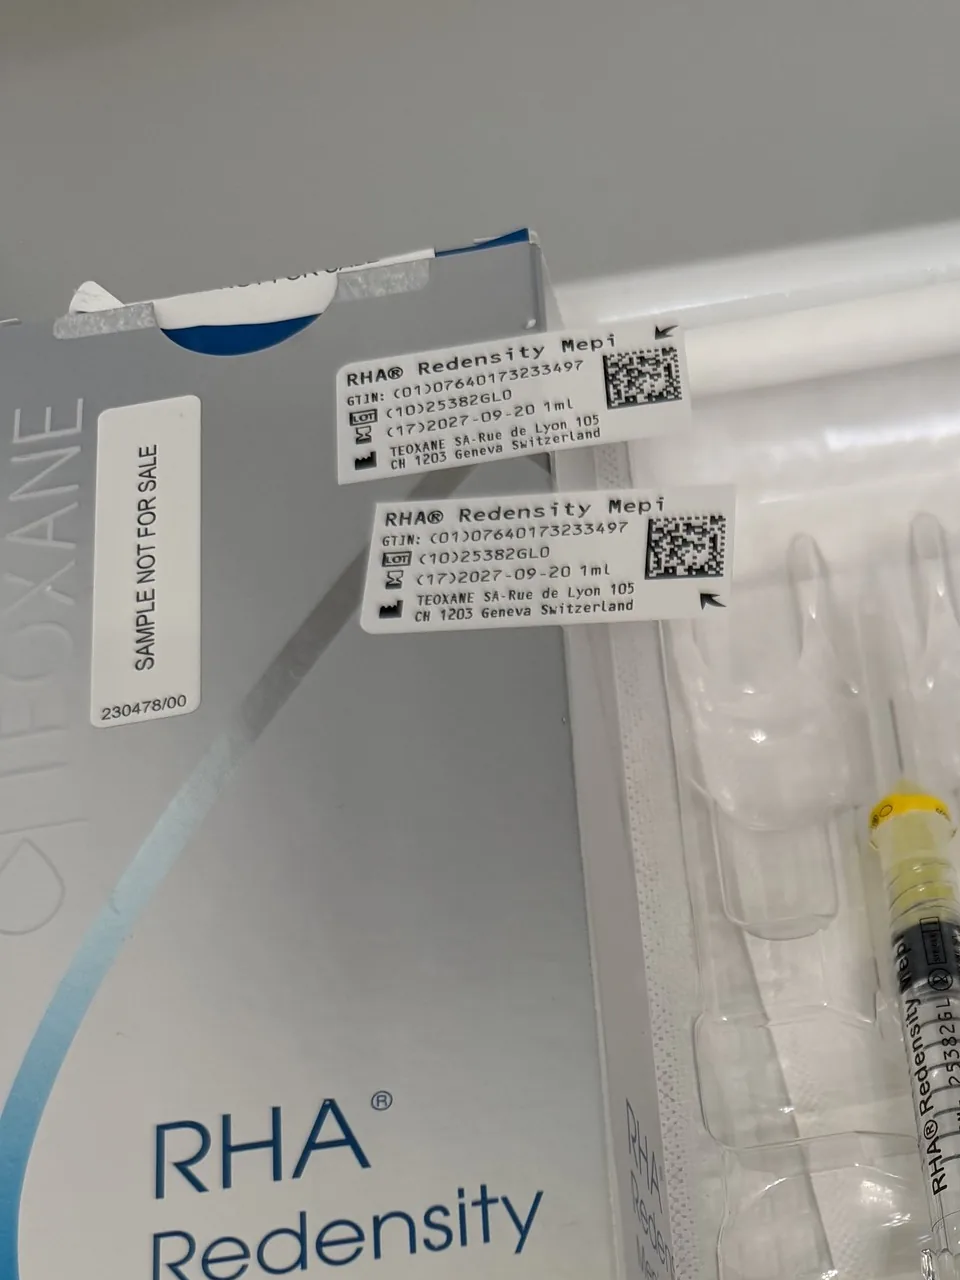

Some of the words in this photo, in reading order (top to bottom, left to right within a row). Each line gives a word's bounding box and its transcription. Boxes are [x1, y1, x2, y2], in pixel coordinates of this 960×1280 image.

[347, 366, 404, 387] RHA®
[417, 343, 545, 376] Redensity
[561, 334, 616, 354] Mepi
[347, 392, 385, 407] GTIN:
[393, 360, 584, 400] (01)07640173233497
[351, 410, 377, 425] LOT
[386, 404, 536, 439] (17)2027-09-20
[544, 399, 574, 414] 1ml
[390, 438, 446, 458] TEOXANE
[454, 430, 503, 448] SA-Rue
[511, 425, 527, 438] de
[535, 419, 568, 436] Lyon
[575, 413, 600, 427] 105
[138, 444, 158, 494] SALE
[390, 458, 406, 471] CH
[414, 451, 447, 467] 1203
[455, 442, 504, 460] Geneva
[512, 427, 601, 451] Switzerland
[137, 497, 157, 537] FOR
[385, 509, 444, 528] RHA®
[458, 499, 592, 523] Redensity
[608, 497, 665, 514] Mepi
[382, 533, 421, 547] GTIN:
[429, 521, 629, 545] (01)07640173233497
[137, 541, 156, 584] NOT
[384, 552, 411, 565] LOT
[416, 565, 571, 586] (17)2027-09-20
[580, 563, 611, 577] 1ml
[414, 609, 431, 623] CH
[440, 606, 474, 620] 1203
[481, 603, 532, 619] Geneva
[540, 599, 635, 616] Switzerland
[417, 591, 475, 607] TEOXANE
[483, 588, 533, 604] SA-Rue
[541, 587, 559, 600] de
[567, 585, 602, 601] Lyon
[610, 582, 635, 596] 105
[135, 587, 155, 671] SAMPLE
[101, 693, 188, 721] 230478/00
[905, 997, 933, 1117] Redensity
[154, 1090, 394, 1199] RHA®
[923, 1118, 948, 1196] RHA®
